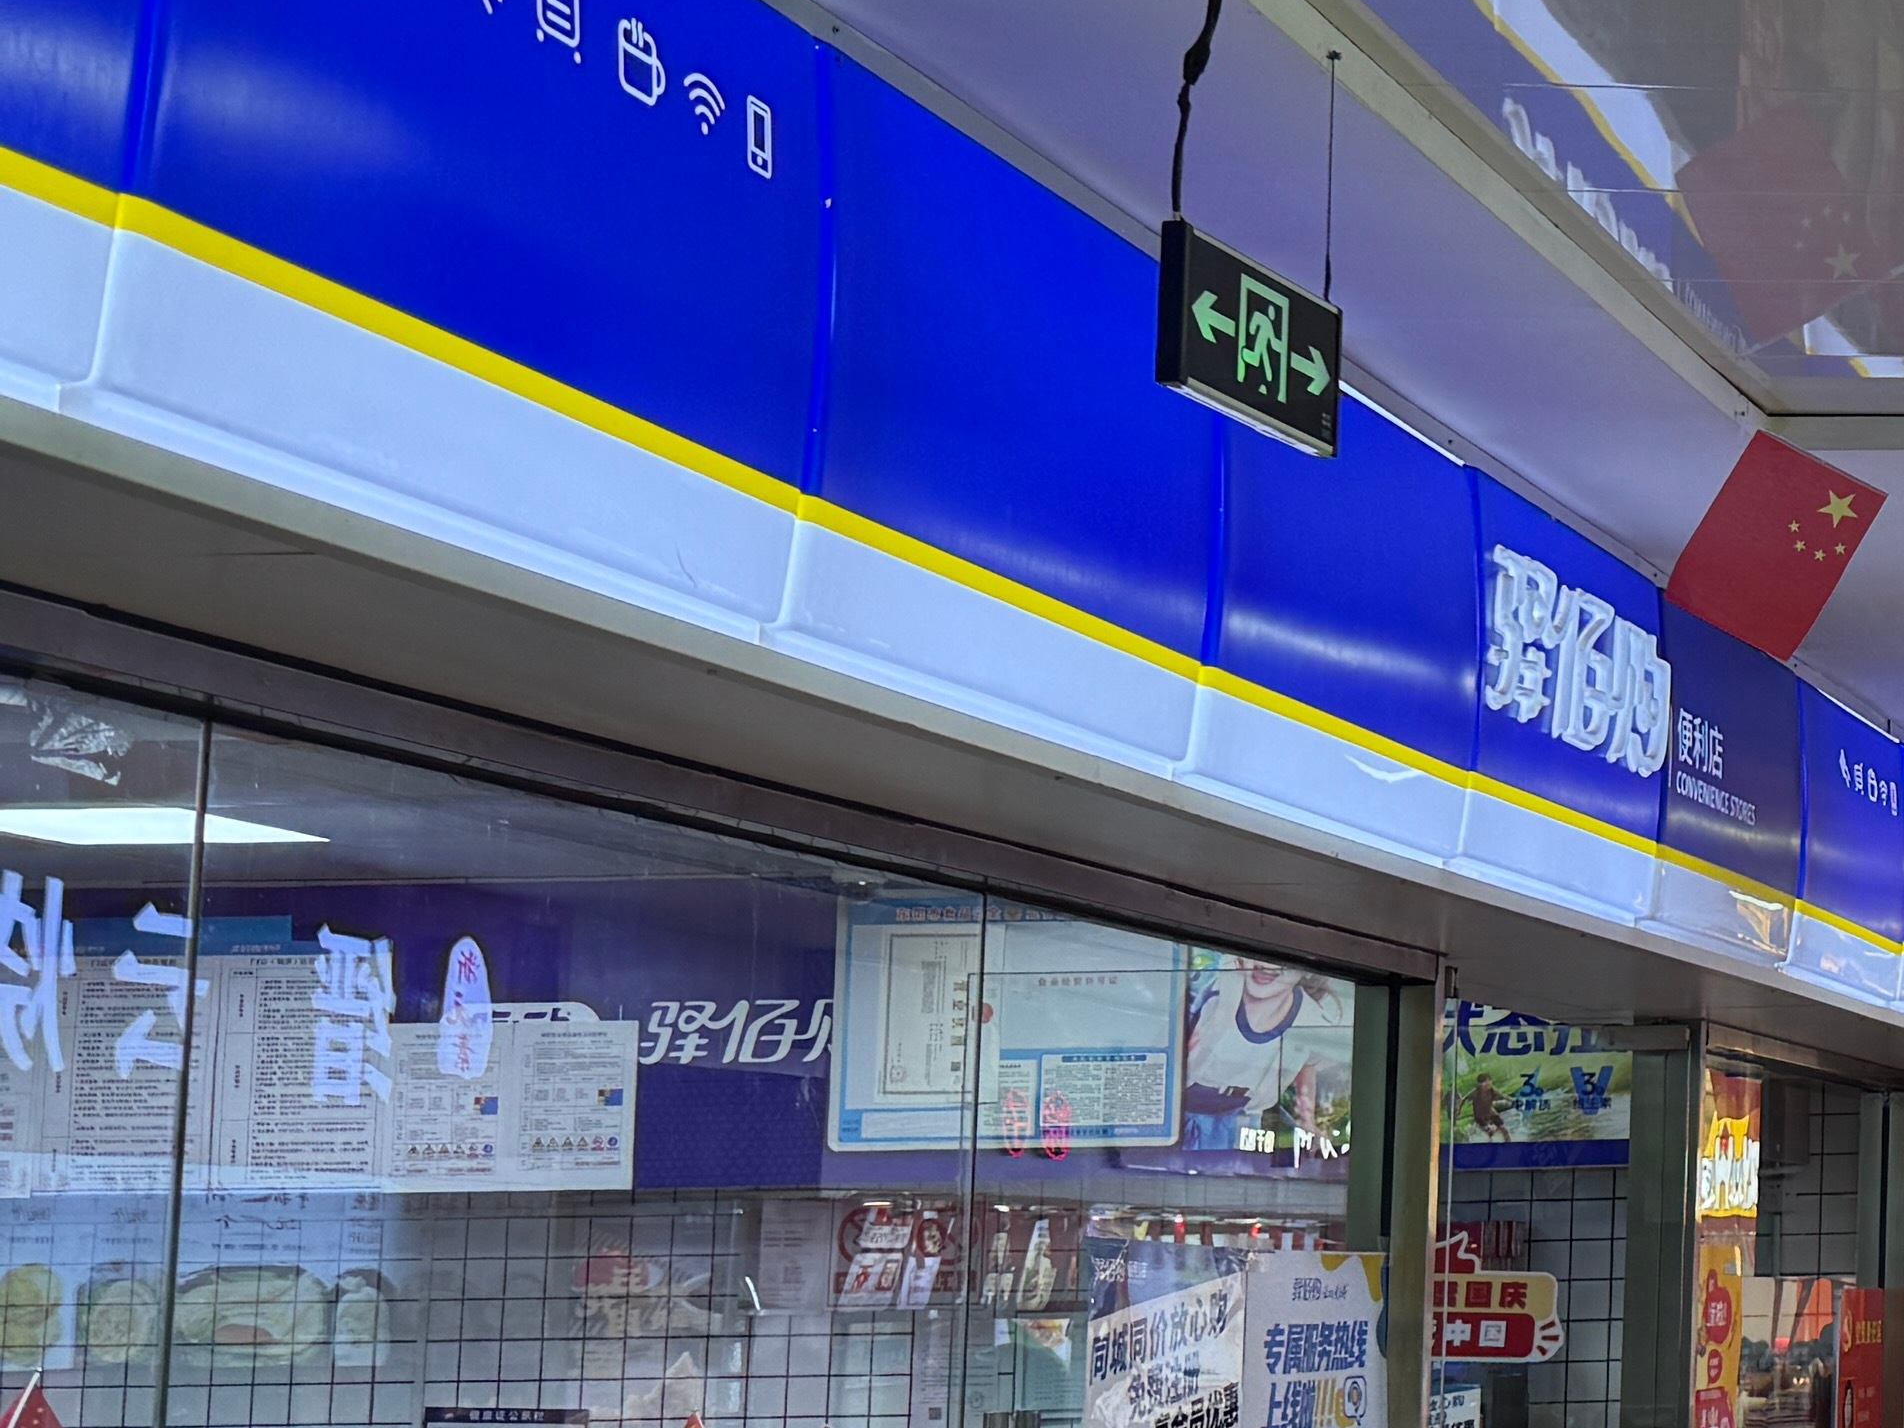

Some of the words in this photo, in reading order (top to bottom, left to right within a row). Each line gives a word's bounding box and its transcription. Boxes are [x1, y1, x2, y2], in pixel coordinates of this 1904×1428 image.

[1676, 706, 1725, 780] 便利店
[1675, 771, 1729, 820] CONVENIENCE
[1729, 794, 1757, 827] STORES
[1089, 1288, 1229, 1386] 同城同价放心购
[1263, 1320, 1369, 1376] 专属服务热线
[1127, 1349, 1200, 1420] 免费注册
